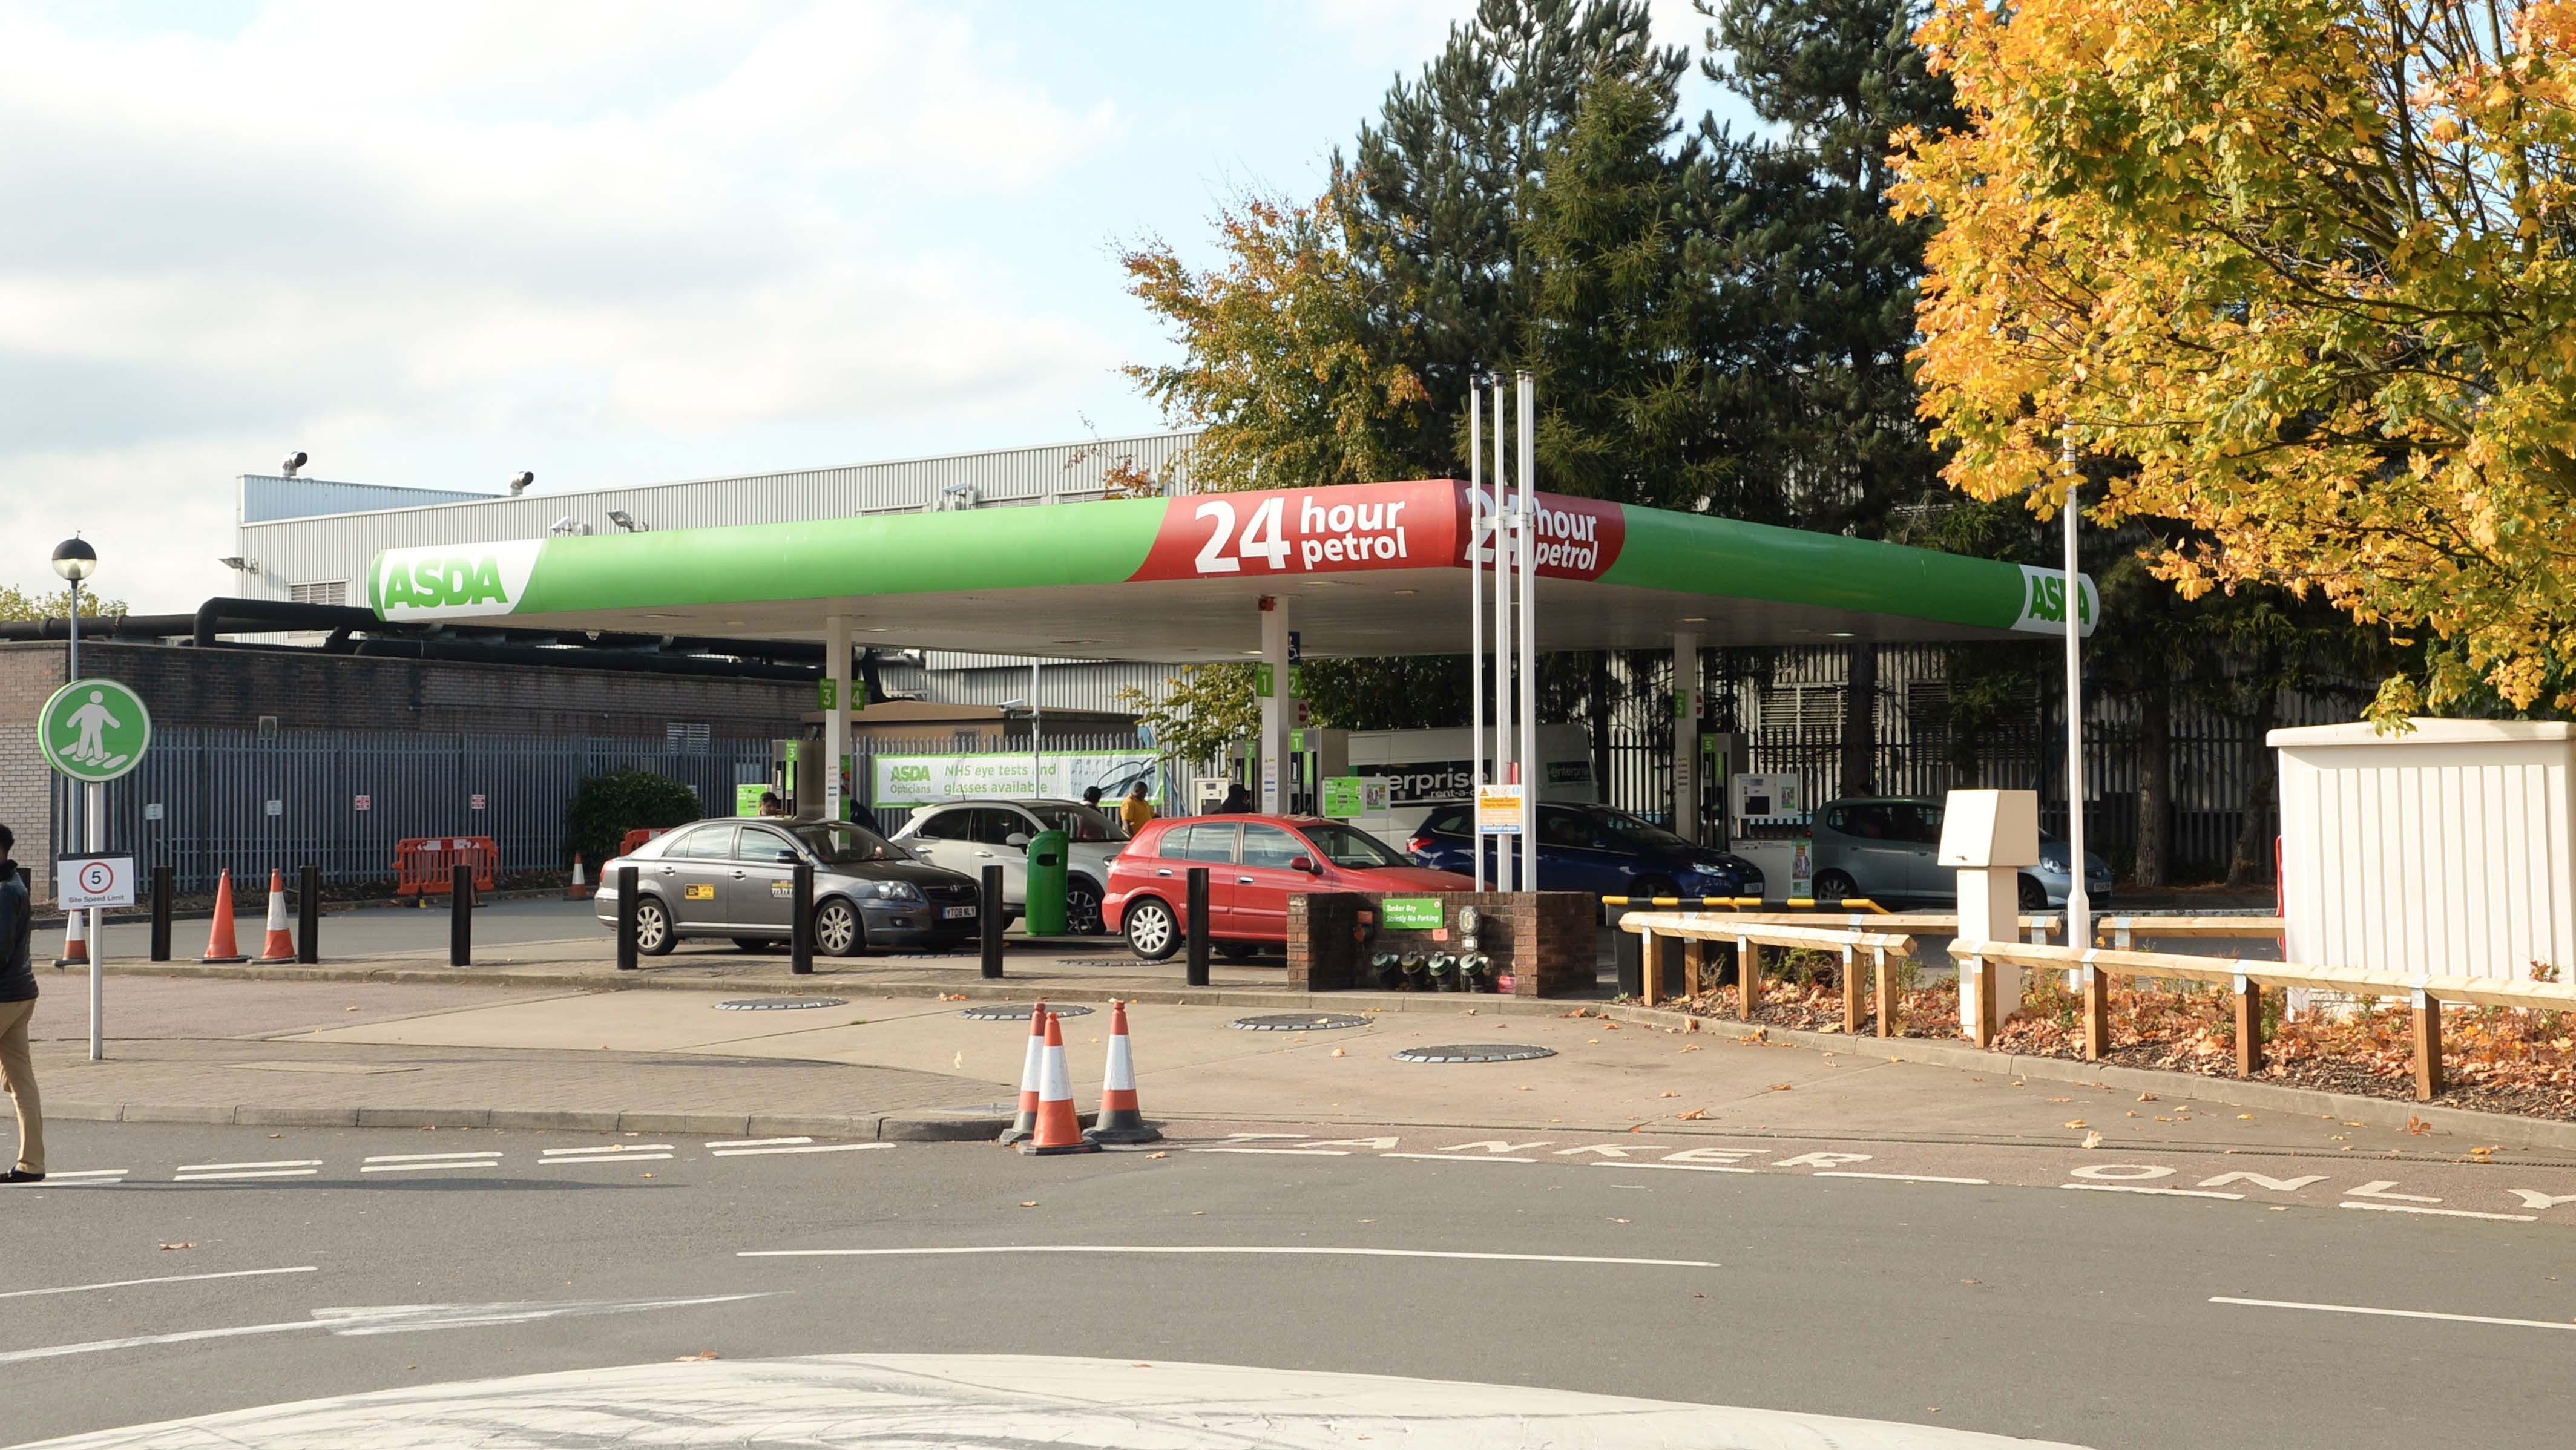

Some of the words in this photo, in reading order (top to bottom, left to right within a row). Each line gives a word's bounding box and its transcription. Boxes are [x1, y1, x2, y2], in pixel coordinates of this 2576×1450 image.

[1533, 497, 1597, 542] hour
[1195, 497, 1291, 573] 24
[1301, 496, 1405, 533] hour
[1301, 526, 1407, 570] petrol
[1533, 540, 1598, 571] petrol
[384, 555, 508, 609] ASDA
[1262, 674, 1267, 692] 1
[1289, 676, 1296, 694] 2
[823, 689, 831, 706] 3
[852, 690, 861, 706] 4
[1295, 738, 1299, 749] 1
[1706, 741, 1712, 750] 5
[789, 748, 795, 758] 3
[1247, 747, 1252, 756] 7
[891, 766, 930, 781] ASDA
[945, 766, 971, 776] NHS
[975, 768, 993, 778] eye
[999, 765, 1027, 775] tests
[891, 784, 930, 795] Opticians
[945, 782, 987, 795] glasses
[991, 782, 1048, 793] availabe
[91, 871, 101, 884] 5
[1387, 915, 1406, 923] Strictly
[1417, 914, 1439, 923] Parking
[1215, 1133, 1873, 1167] TANKER
